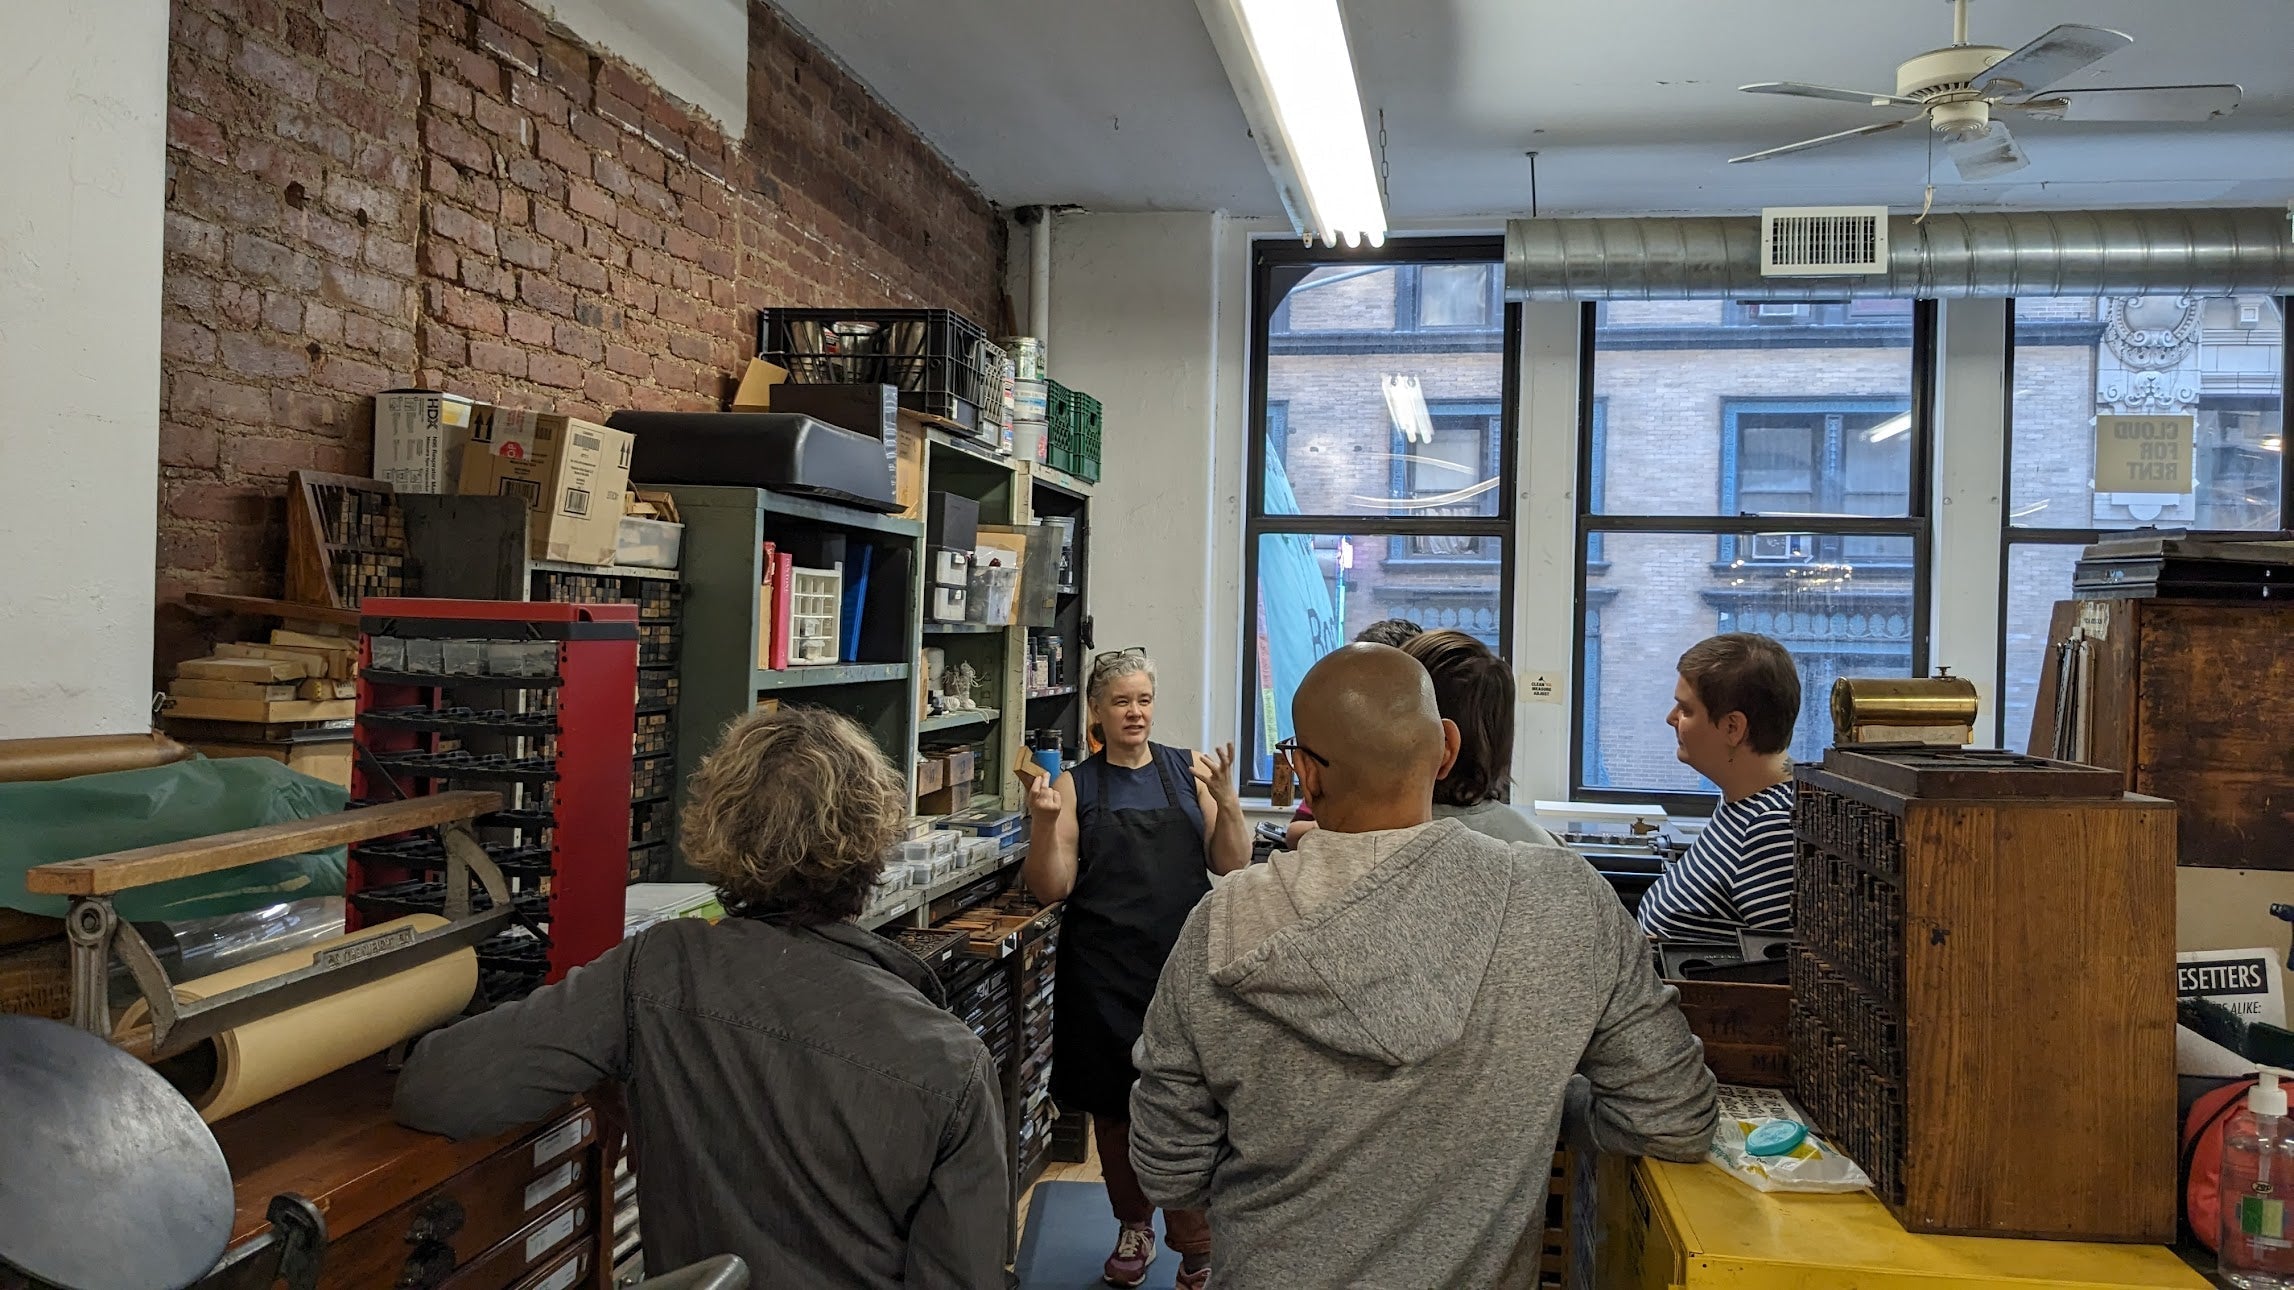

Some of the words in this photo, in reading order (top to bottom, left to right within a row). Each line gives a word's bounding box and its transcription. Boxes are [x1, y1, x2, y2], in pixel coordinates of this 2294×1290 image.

[427, 398, 439, 430] HDX
[2178, 964, 2262, 991] ESETTERS
[2231, 1001, 2262, 1015] ALIKE:
